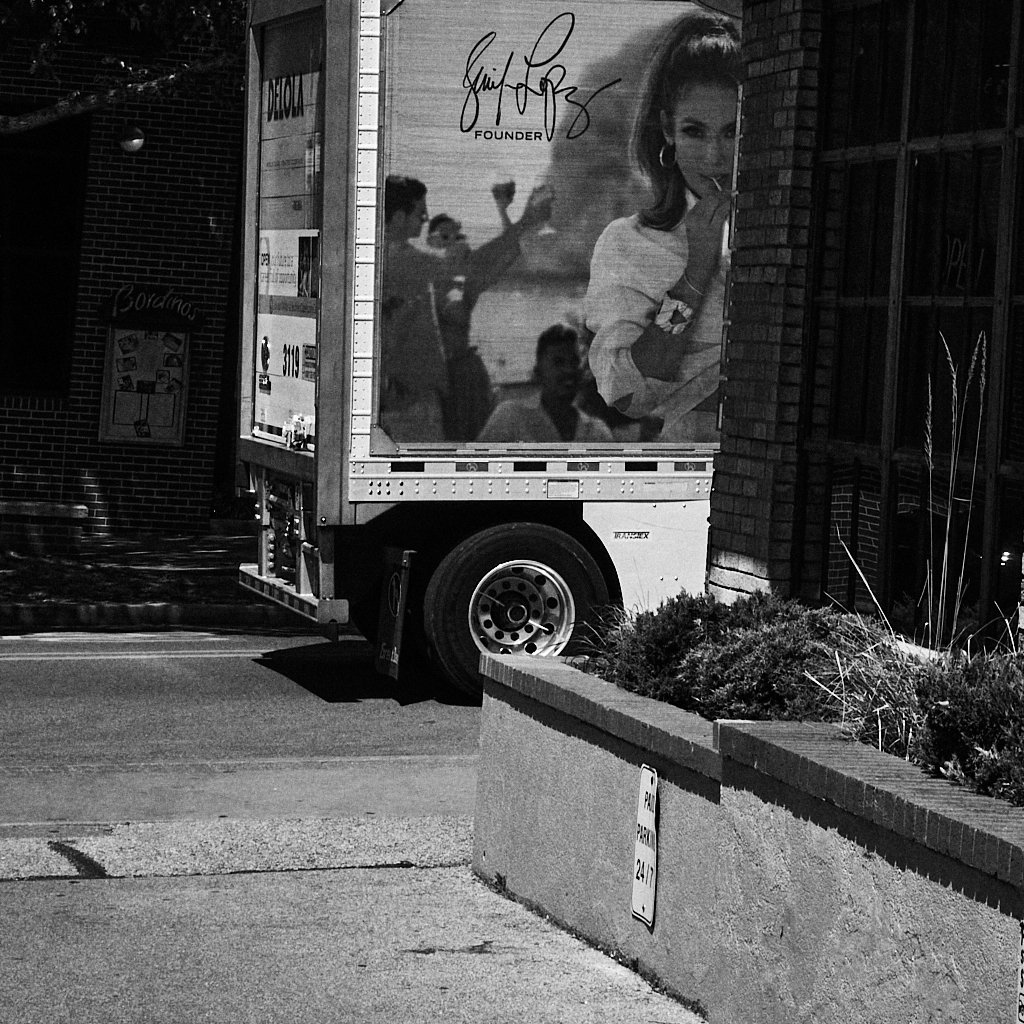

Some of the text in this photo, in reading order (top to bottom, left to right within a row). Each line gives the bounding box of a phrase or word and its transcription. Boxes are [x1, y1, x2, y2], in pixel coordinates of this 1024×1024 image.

[267, 72, 304, 123] DELOLA
[474, 130, 543, 141] FOUNDER
[282, 343, 300, 379] 3119
[635, 858, 654, 889] 24/7
